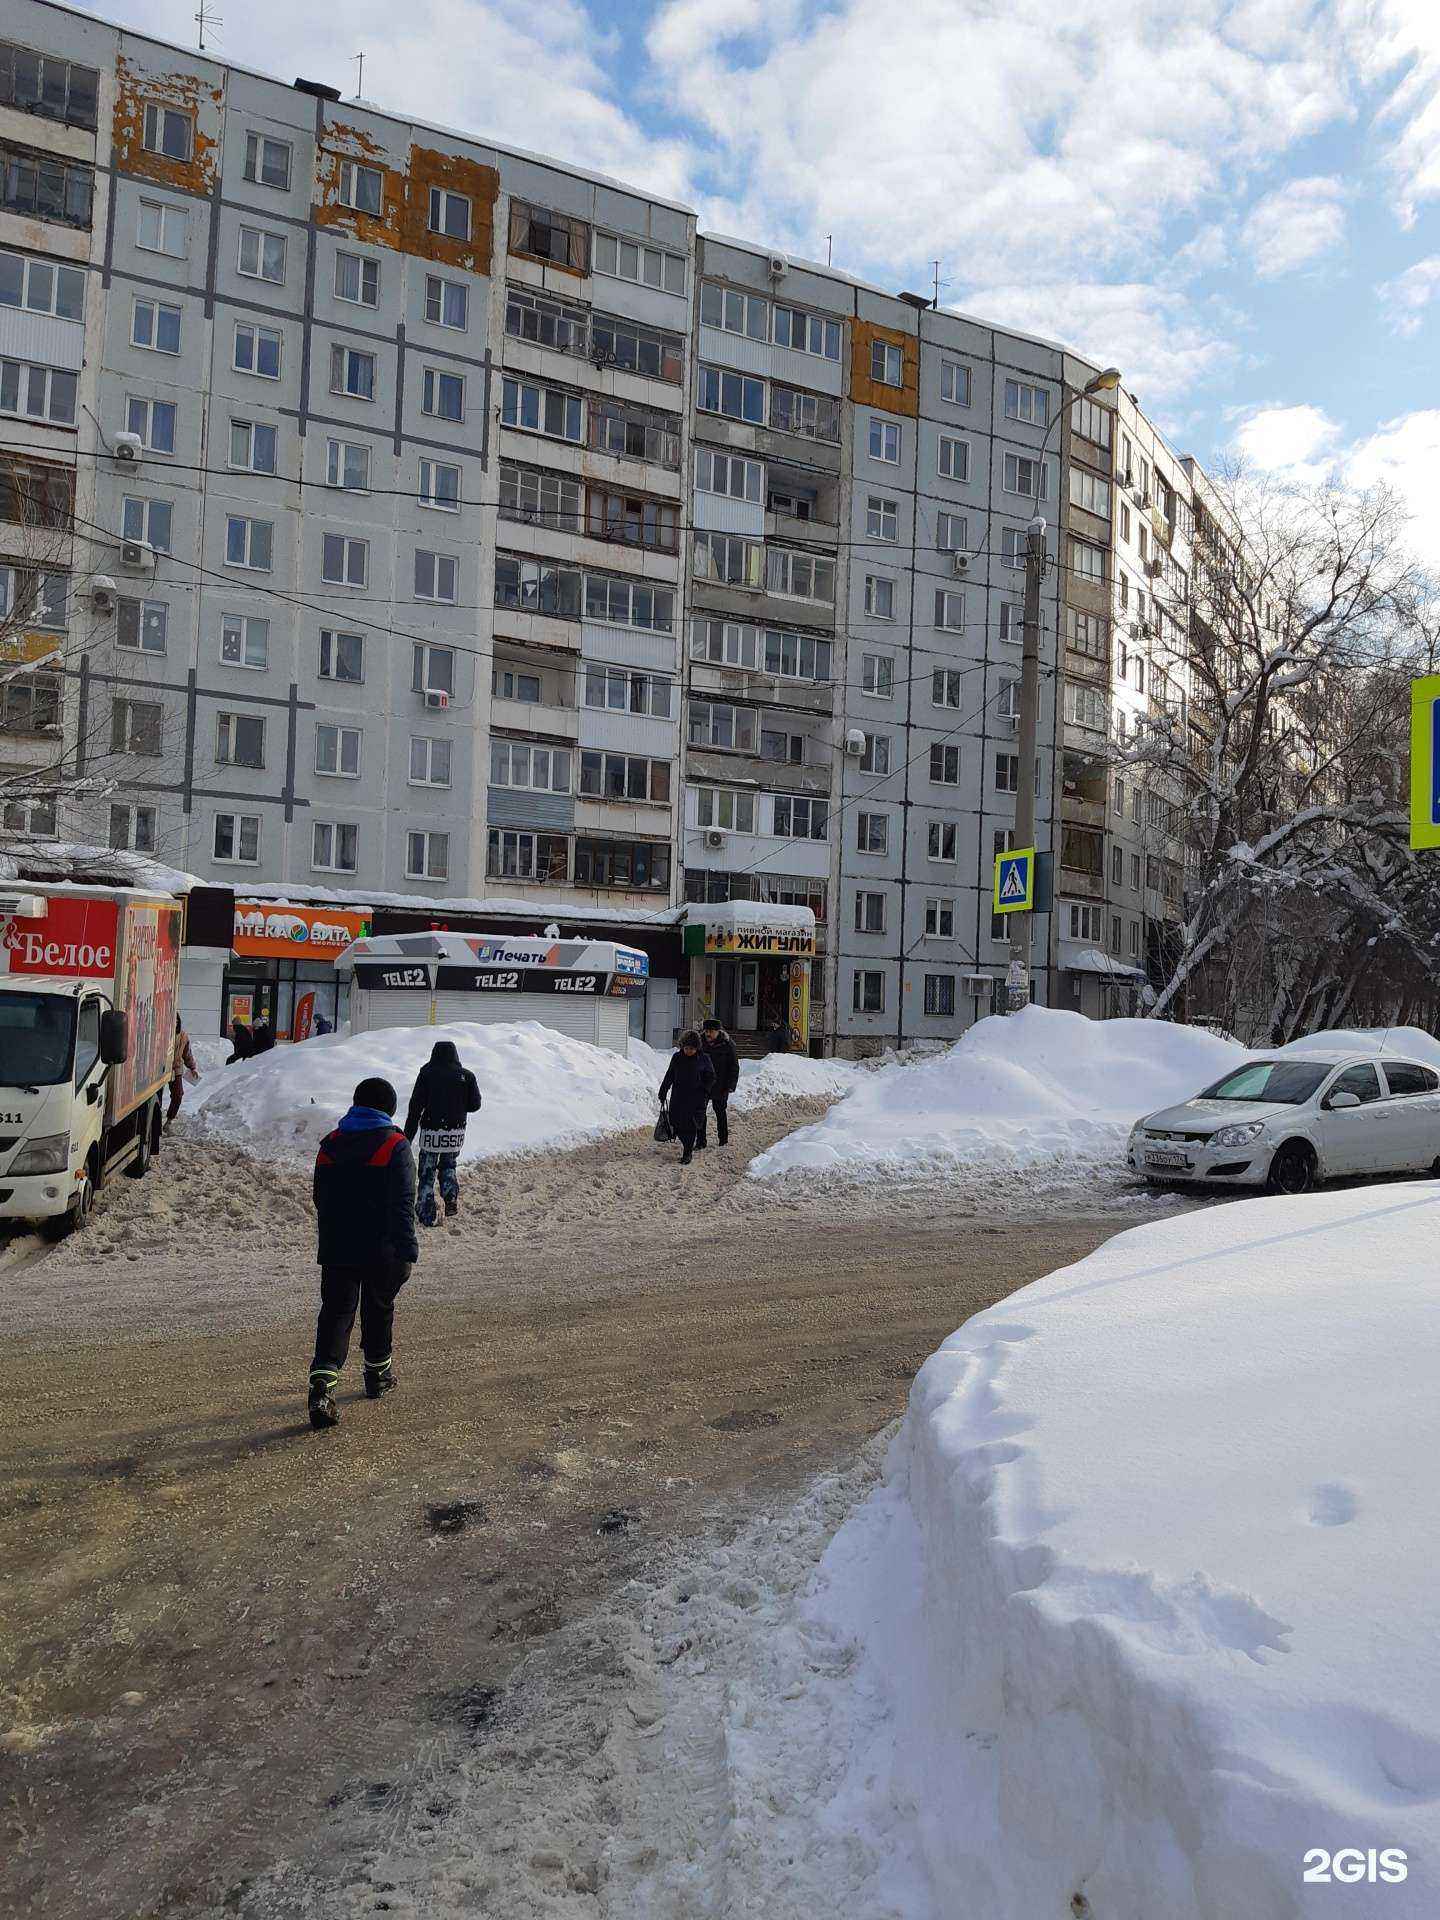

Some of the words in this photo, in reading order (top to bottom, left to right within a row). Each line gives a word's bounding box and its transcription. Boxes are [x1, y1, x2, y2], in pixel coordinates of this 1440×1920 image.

[310, 925, 352, 942] ВИТА
[776, 929, 813, 937] магазин
[22, 933, 110, 968] Белое
[737, 934, 812, 952] ЖИГУЛИ
[492, 949, 547, 964] Печать
[382, 968, 427, 987] TELE2
[475, 972, 518, 988] TELE2
[554, 975, 596, 991] TELE2
